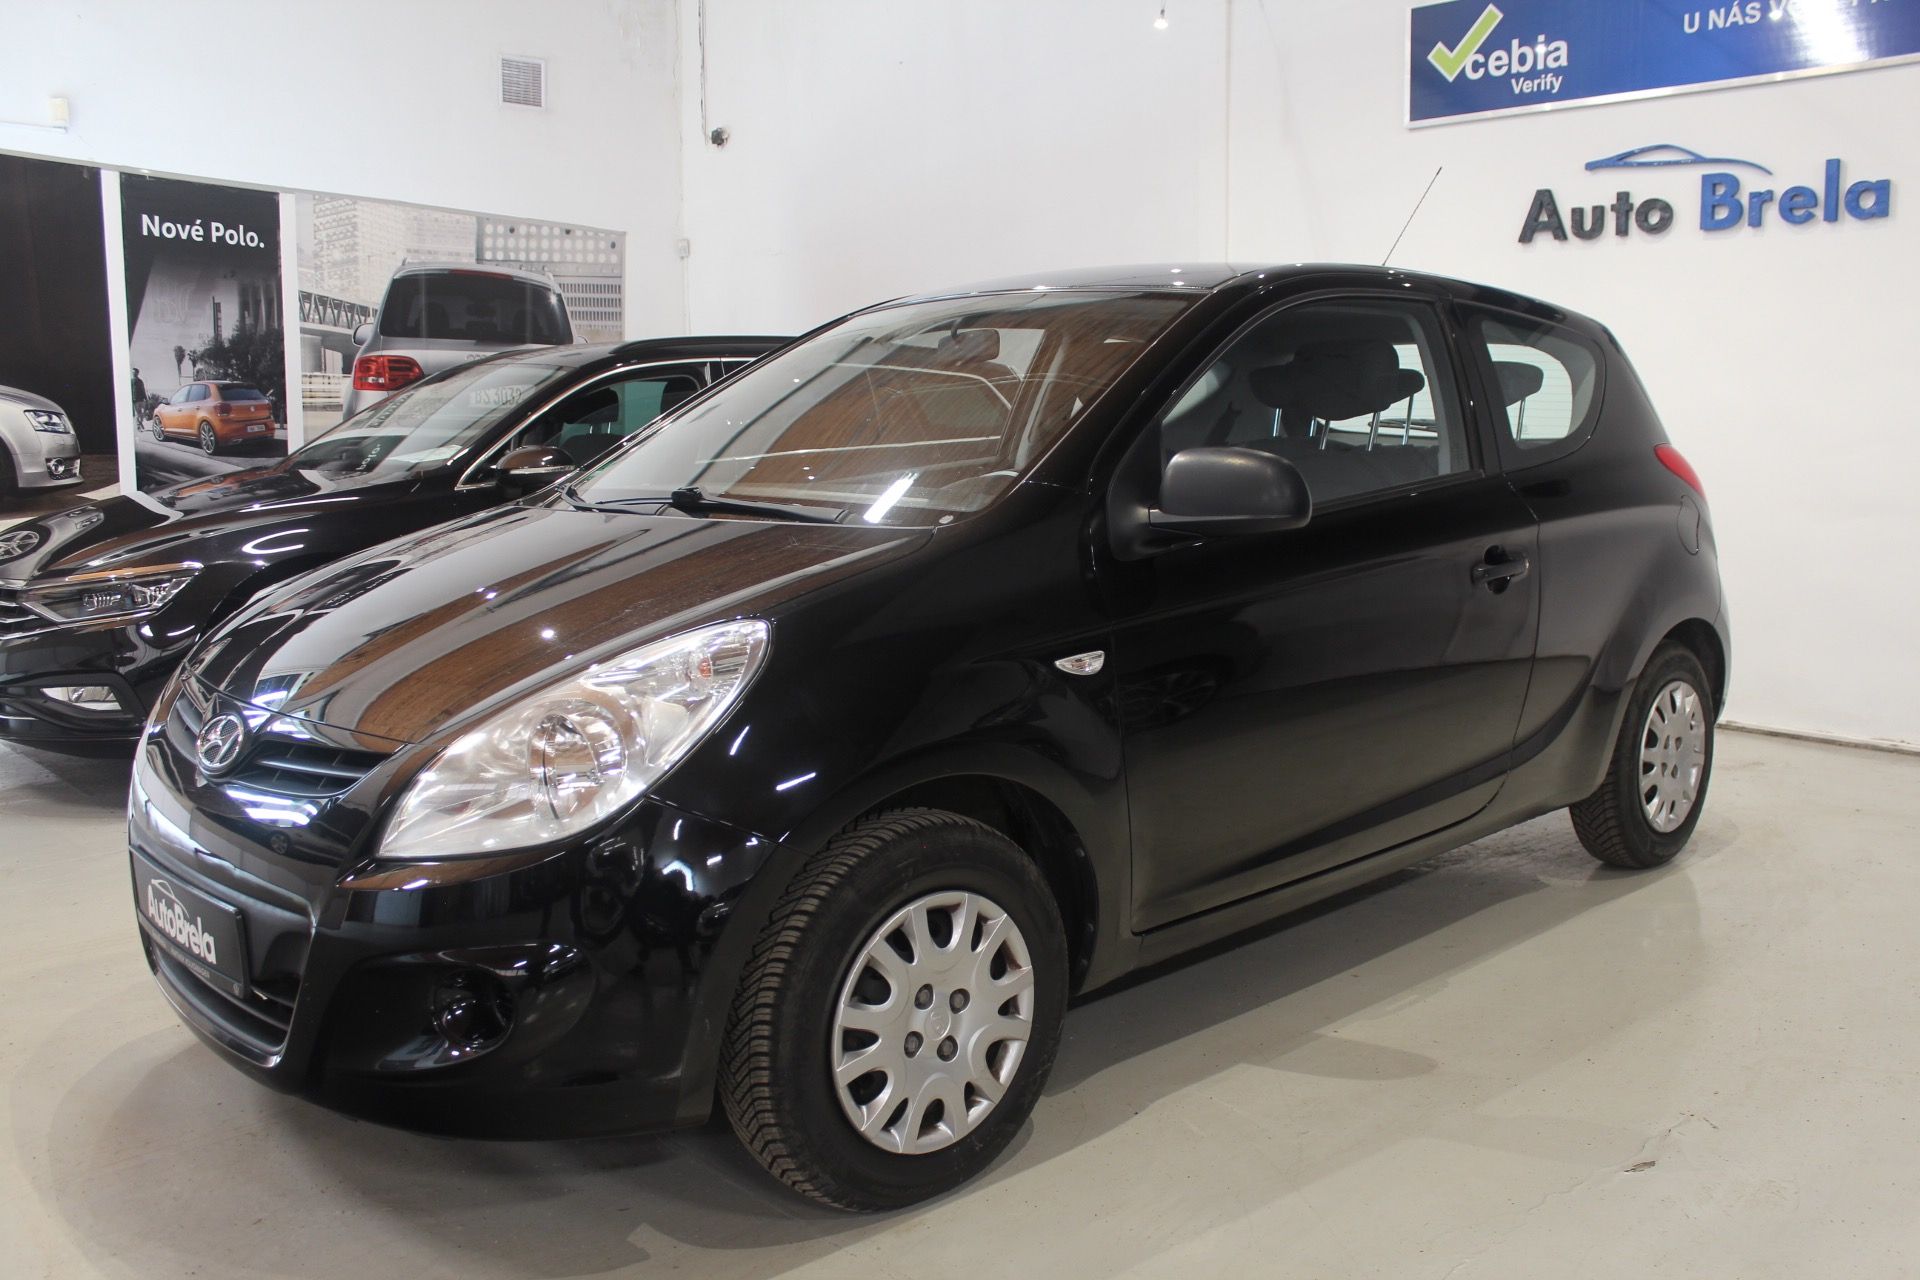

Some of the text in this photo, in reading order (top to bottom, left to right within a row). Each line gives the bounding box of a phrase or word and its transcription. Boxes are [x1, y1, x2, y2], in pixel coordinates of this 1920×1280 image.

[1683, 12, 1700, 34] U
[1707, 0, 1762, 31] NÁS
[1465, 34, 1568, 80] cebia
[1511, 73, 1563, 94] Verify
[1518, 158, 1891, 244] Auto Brela
[141, 213, 265, 248] Nové Polo.
[147, 884, 217, 965] AutoBrela
